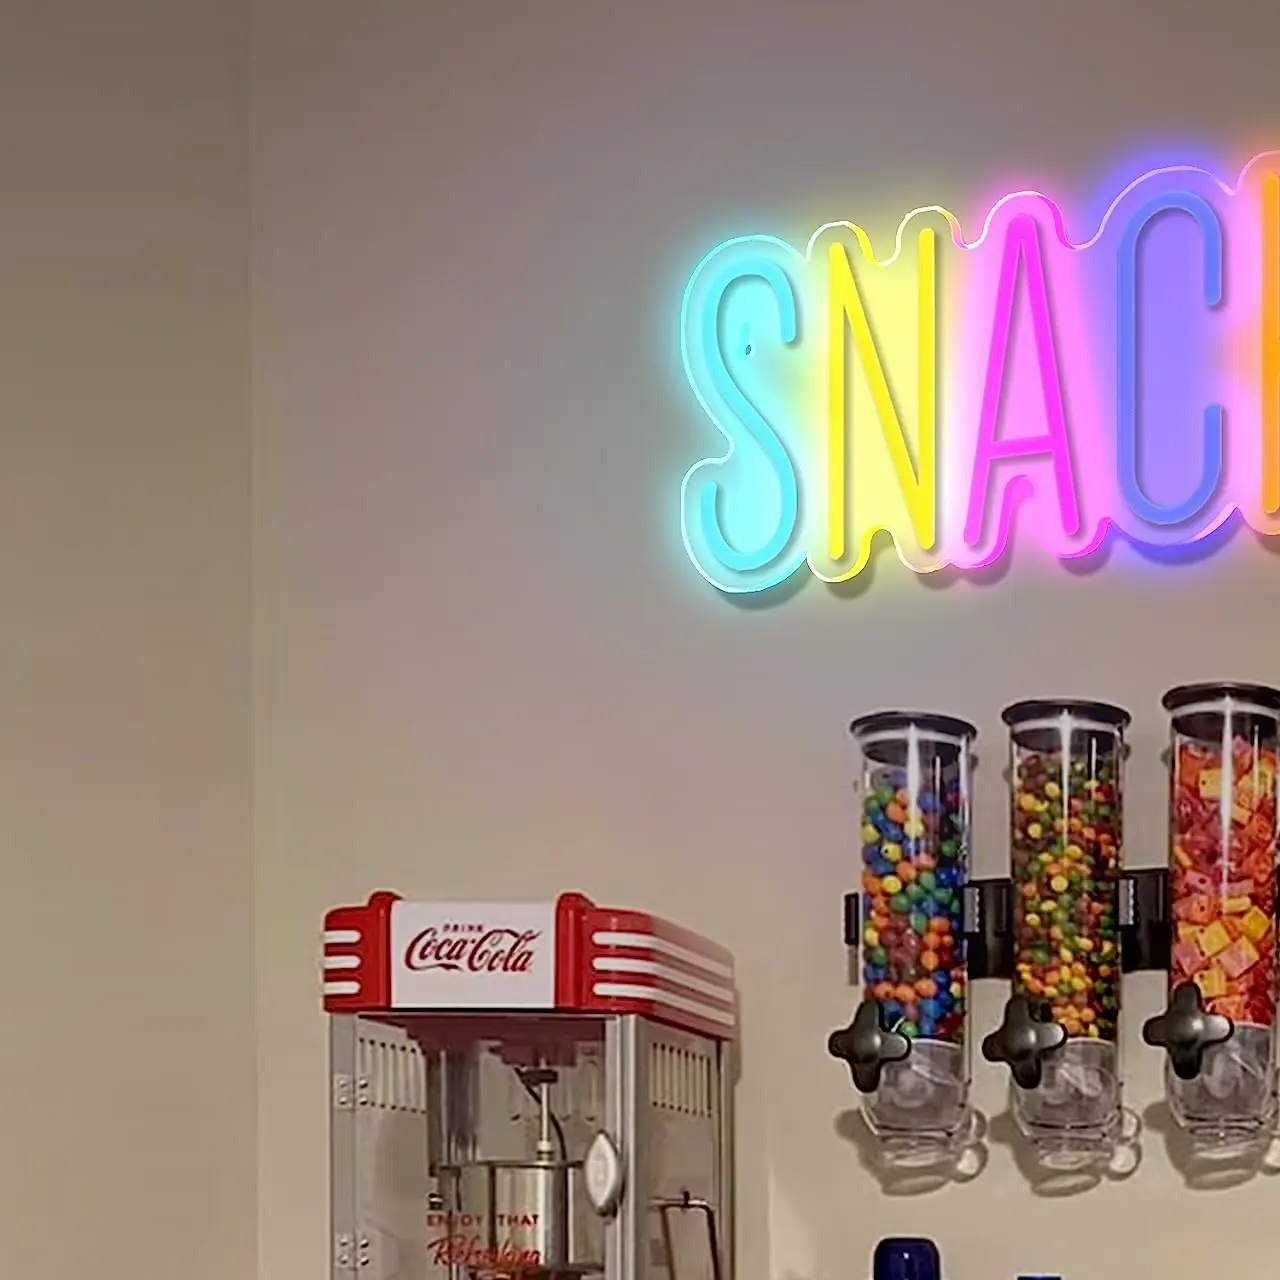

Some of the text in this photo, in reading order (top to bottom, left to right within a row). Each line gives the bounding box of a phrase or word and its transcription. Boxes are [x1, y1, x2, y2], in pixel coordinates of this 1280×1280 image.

[404, 926, 543, 973] Coca-Cola
[426, 1213, 482, 1227] ENJOY
[498, 1214, 540, 1227] THAT
